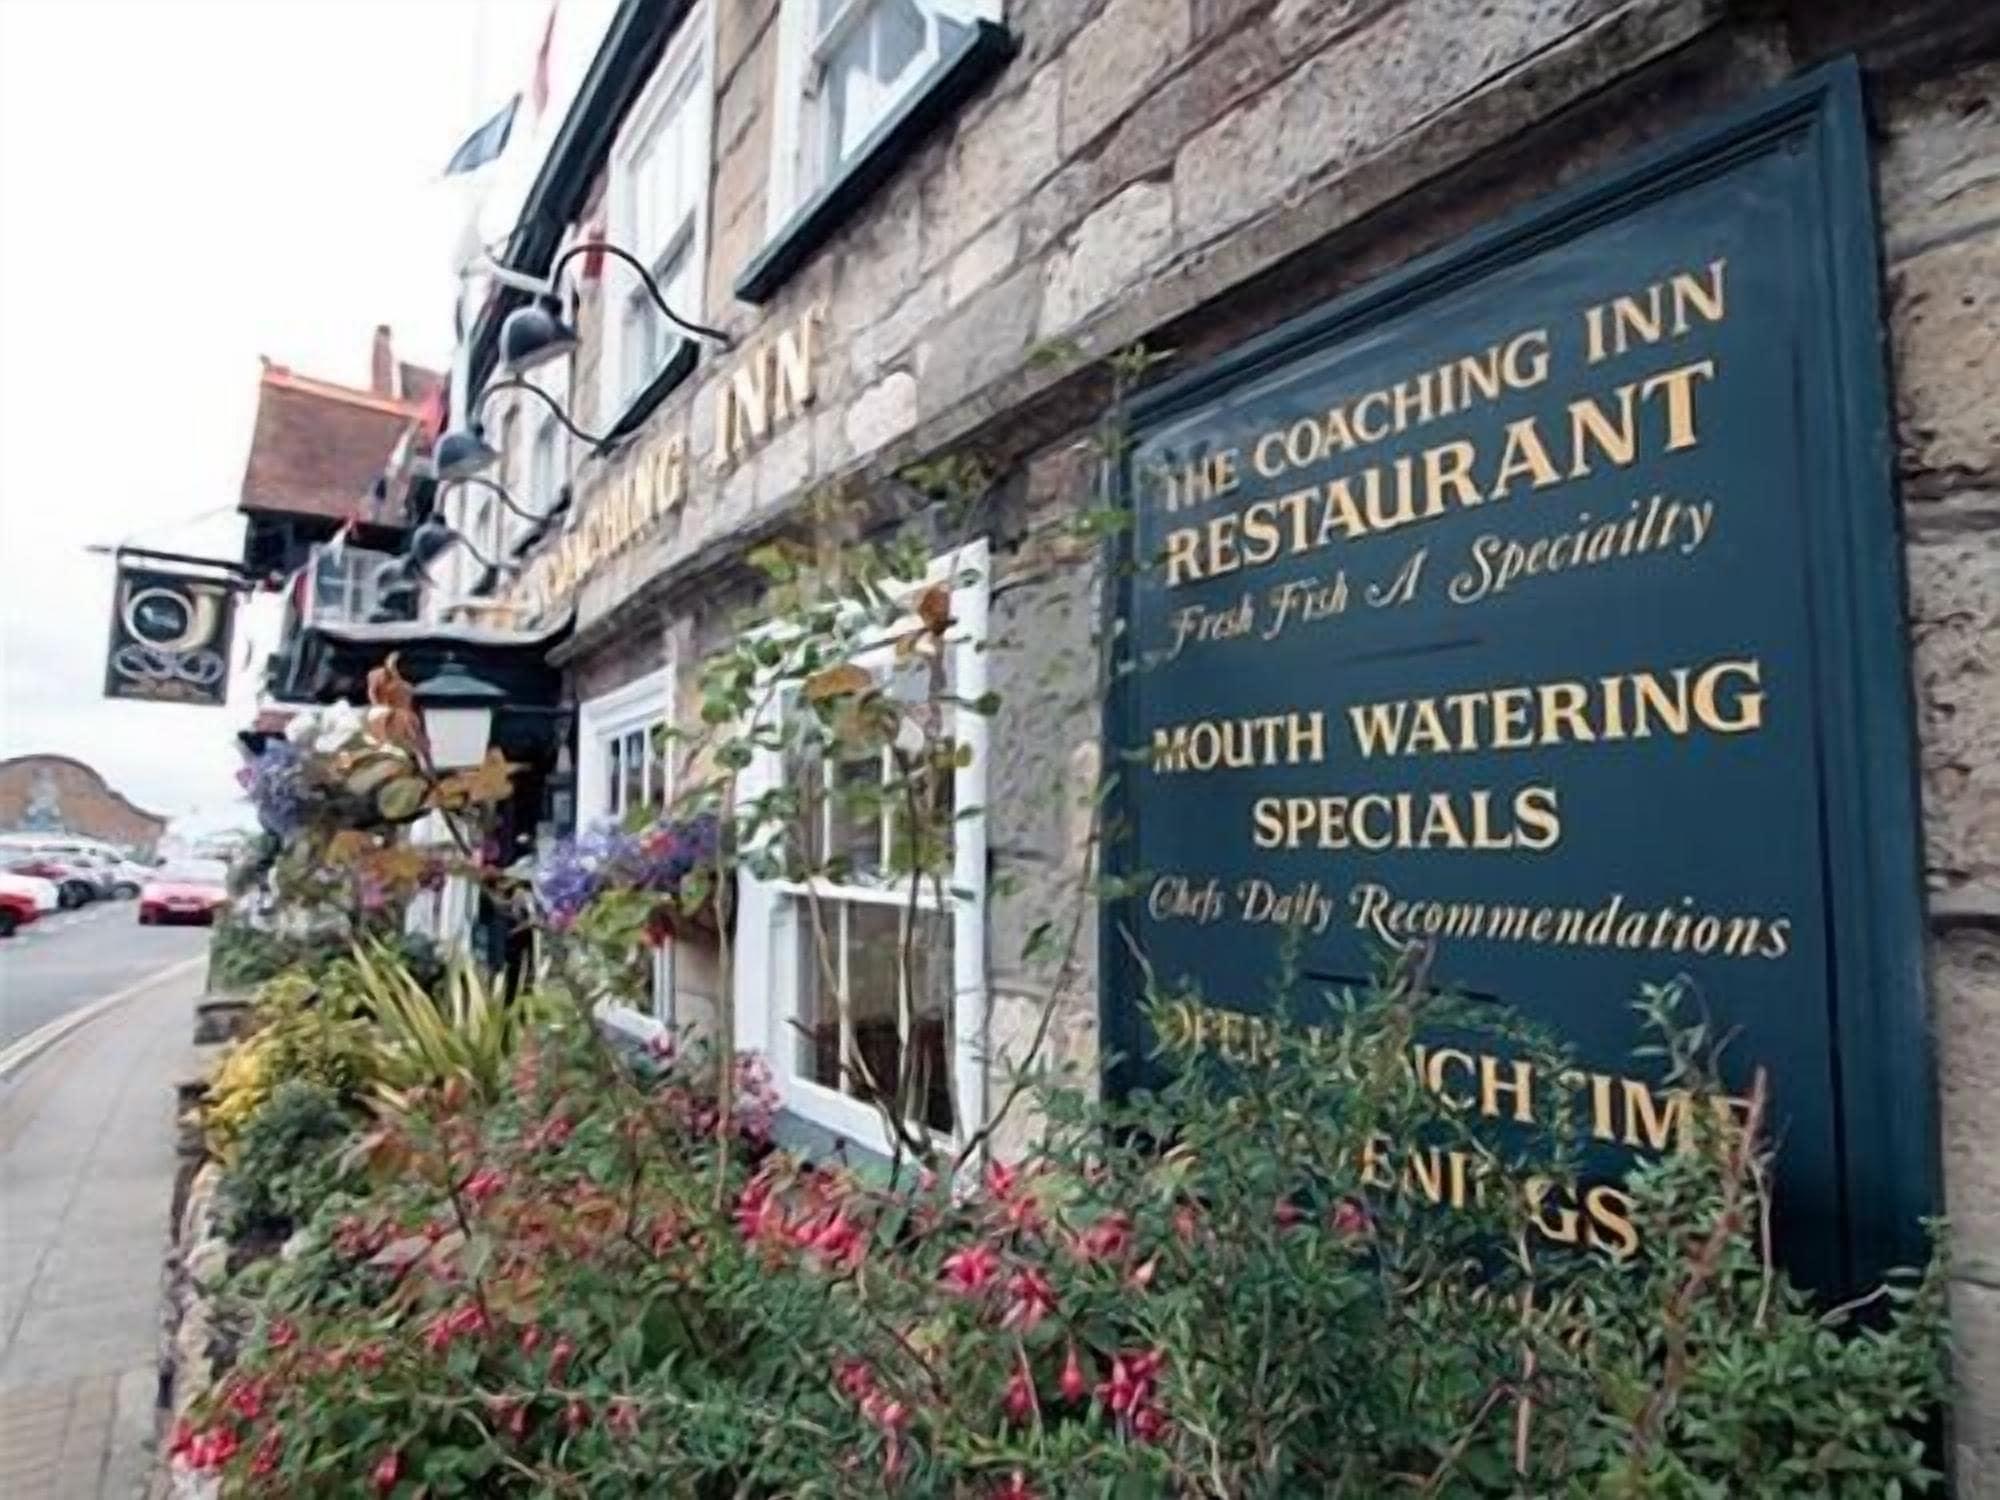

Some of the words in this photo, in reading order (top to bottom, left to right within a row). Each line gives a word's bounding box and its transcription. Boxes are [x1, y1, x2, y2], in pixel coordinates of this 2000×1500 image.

[713, 302, 824, 464] INN
[1155, 447, 1240, 513] THE
[1253, 328, 1551, 478] COACHING
[1586, 257, 1728, 364] INN
[1164, 360, 1715, 588] RESTAURANT
[1364, 547, 1428, 608] A
[1152, 712, 1325, 775] MOUTH
[1350, 659, 1765, 759] WATERING
[1252, 786, 1561, 850] SPECIALS
[1350, 881, 1792, 961] Recommendations
